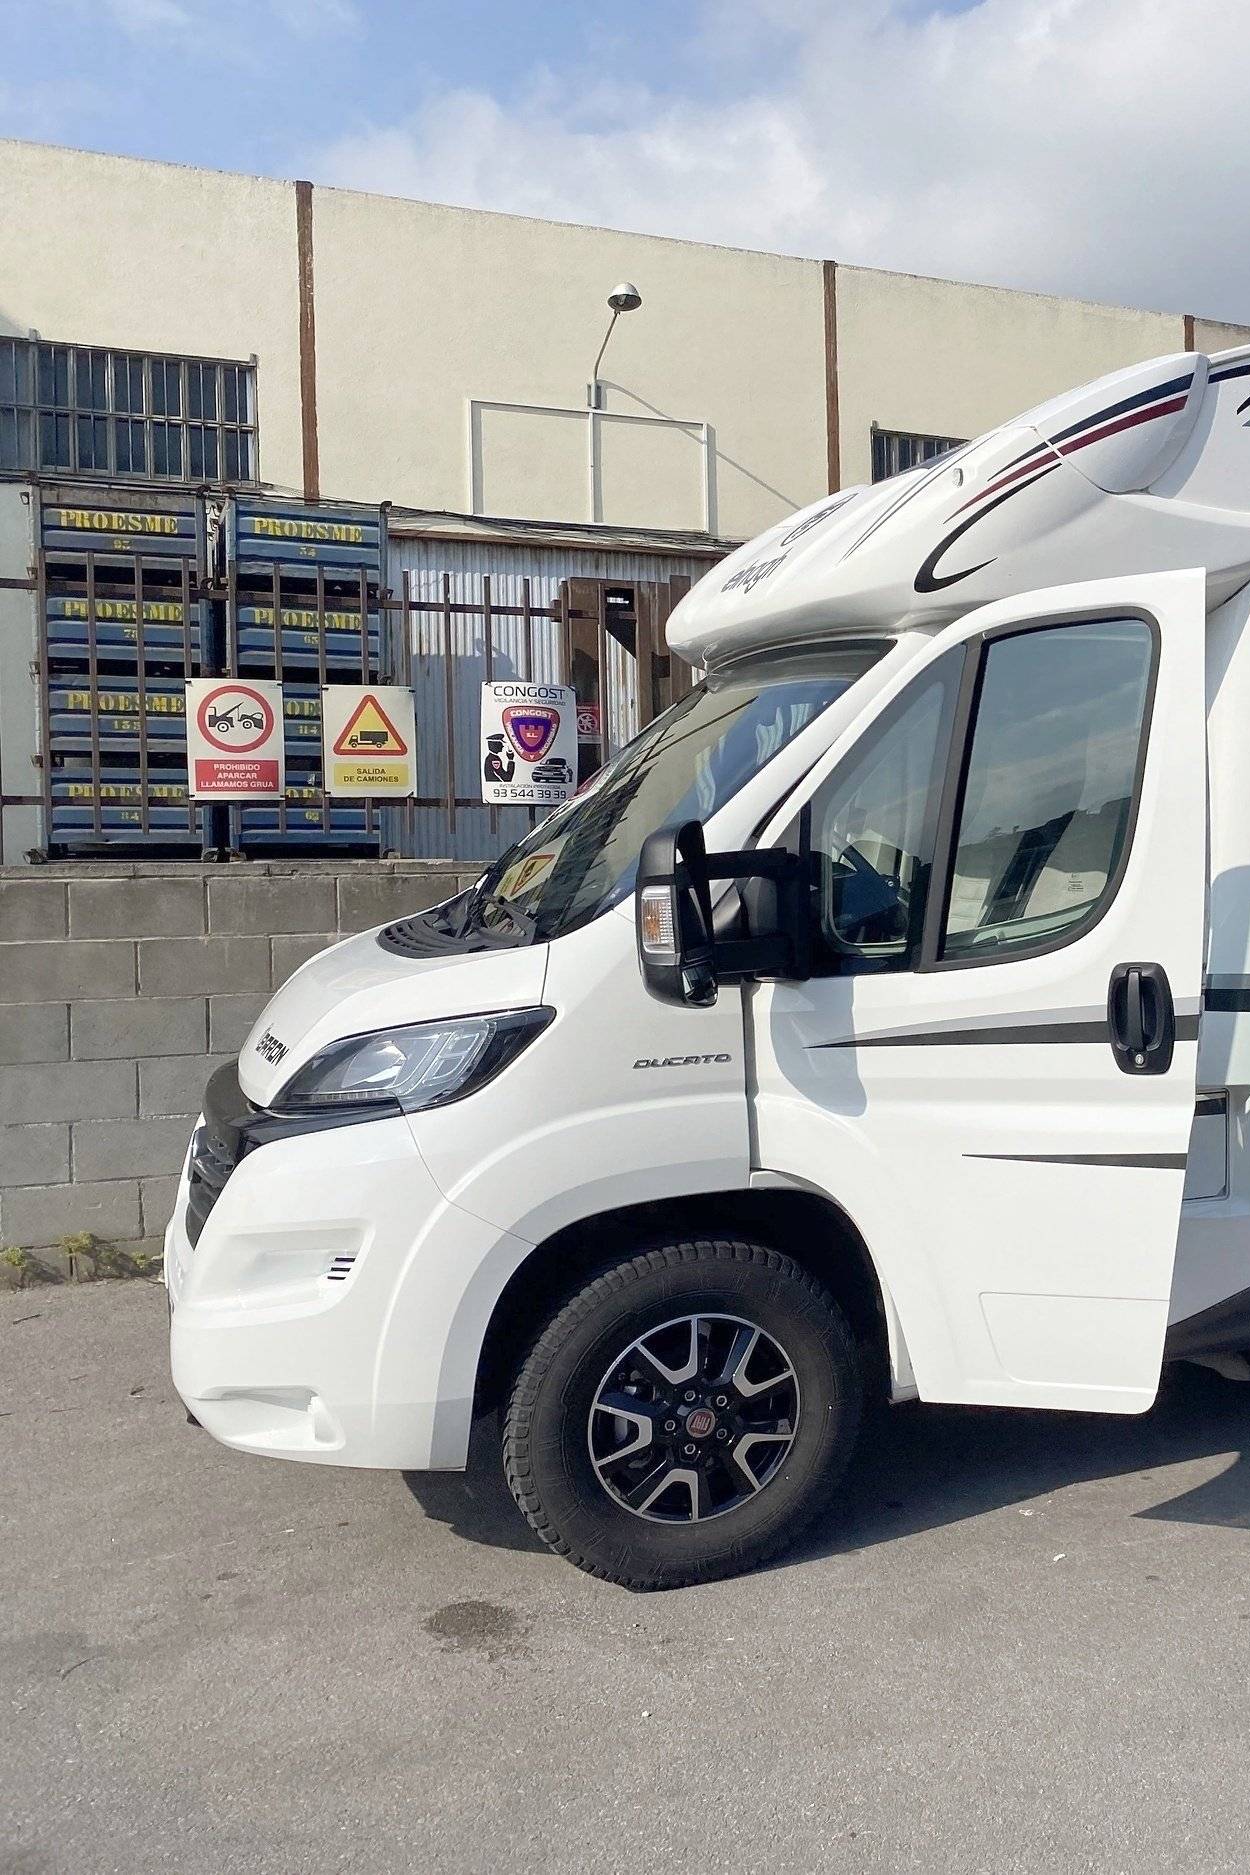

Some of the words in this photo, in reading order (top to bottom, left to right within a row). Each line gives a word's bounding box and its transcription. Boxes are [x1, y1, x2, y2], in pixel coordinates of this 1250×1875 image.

[60, 511, 178, 534] PROESME
[254, 517, 363, 542] PROESME
[493, 685, 566, 700] CONGOST
[510, 709, 553, 719] CONGOST
[213, 763, 261, 771] PROHIBIDO
[217, 772, 258, 780] APARCAR
[343, 775, 355, 783] DE
[356, 775, 399, 783] CAMIONES
[200, 780, 249, 788] LLAMAMOS
[249, 780, 274, 788] GRUA
[493, 788, 508, 798] 93
[510, 789, 535, 798] 544
[537, 789, 552, 799] 39
[553, 790, 567, 799] 39
[632, 1053, 732, 1070] DUCATO
